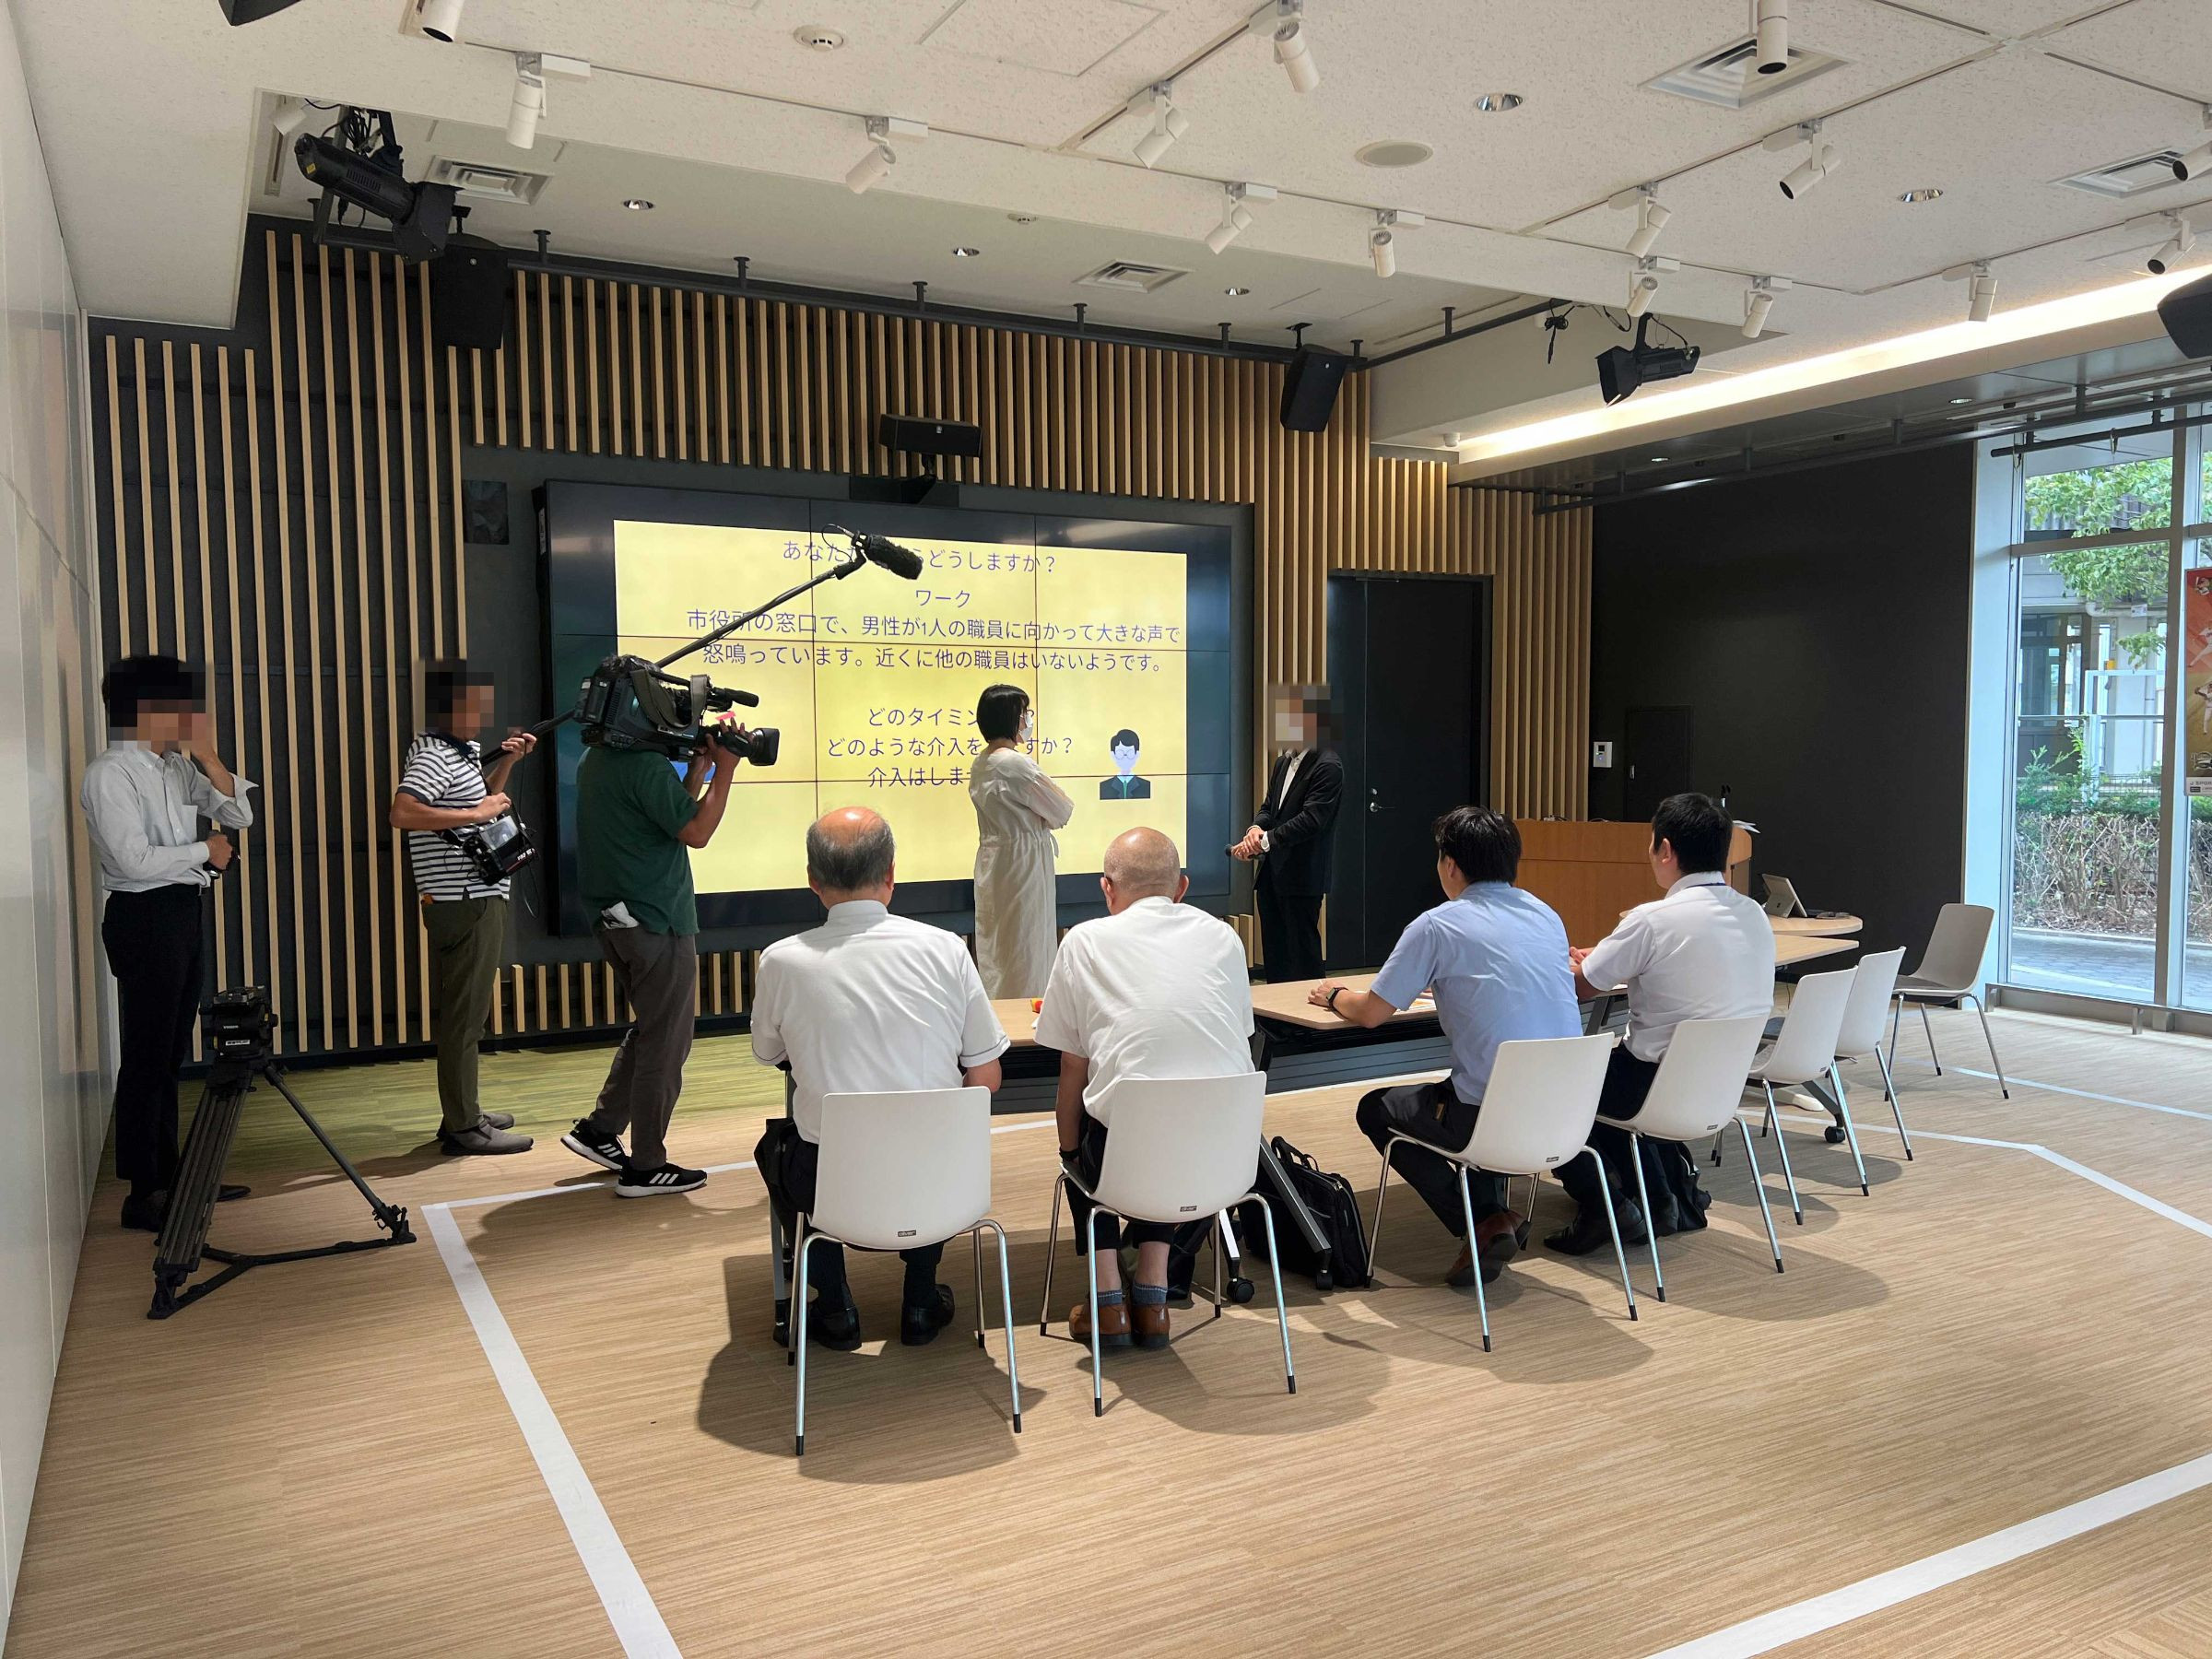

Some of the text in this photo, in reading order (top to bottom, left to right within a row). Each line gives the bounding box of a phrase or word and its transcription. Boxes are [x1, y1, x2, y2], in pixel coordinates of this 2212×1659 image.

[915, 590, 971, 608] ワーク
[703, 643, 1160, 673] 怒鳴っています。近くに他の職員はいないようです。
[828, 737, 1073, 757] どのような介入をすか？
[868, 767, 971, 788] 介入はしま
